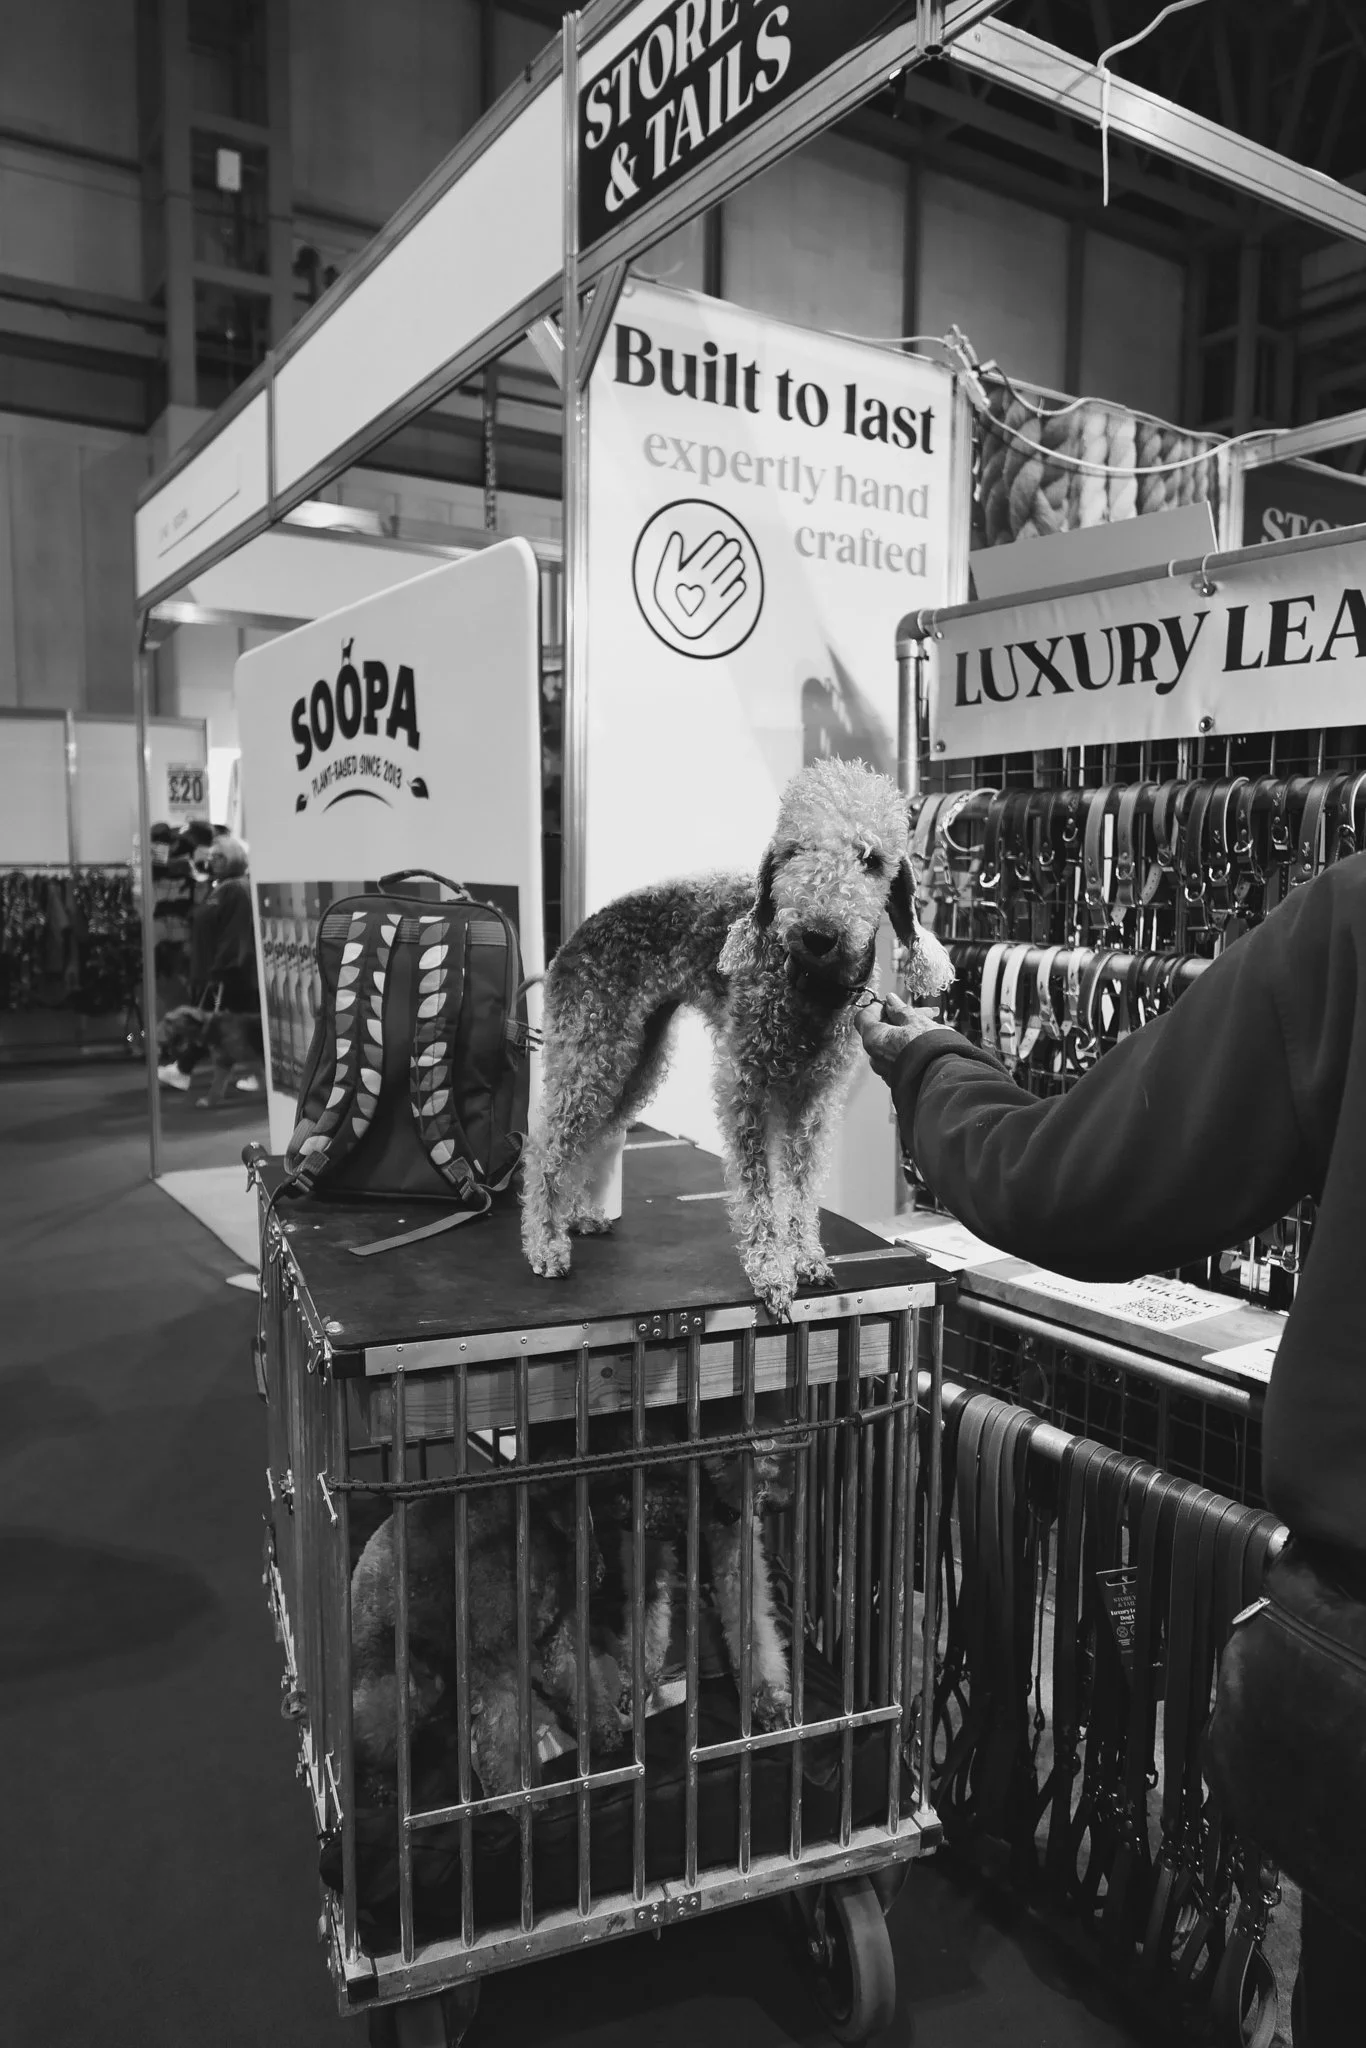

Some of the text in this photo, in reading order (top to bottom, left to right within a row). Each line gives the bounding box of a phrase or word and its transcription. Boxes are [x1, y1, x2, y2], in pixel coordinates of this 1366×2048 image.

[585, 0, 763, 150] STORE
[604, 4, 792, 213] & TAILS
[613, 323, 936, 454] Built to last
[643, 431, 930, 520] expertly hand
[794, 525, 928, 578] crafted
[954, 588, 1366, 707] LUXURY LEA
[290, 660, 421, 772] SOOPA
[359, 754, 381, 778] SINCE
[168, 774, 204, 804] £20
